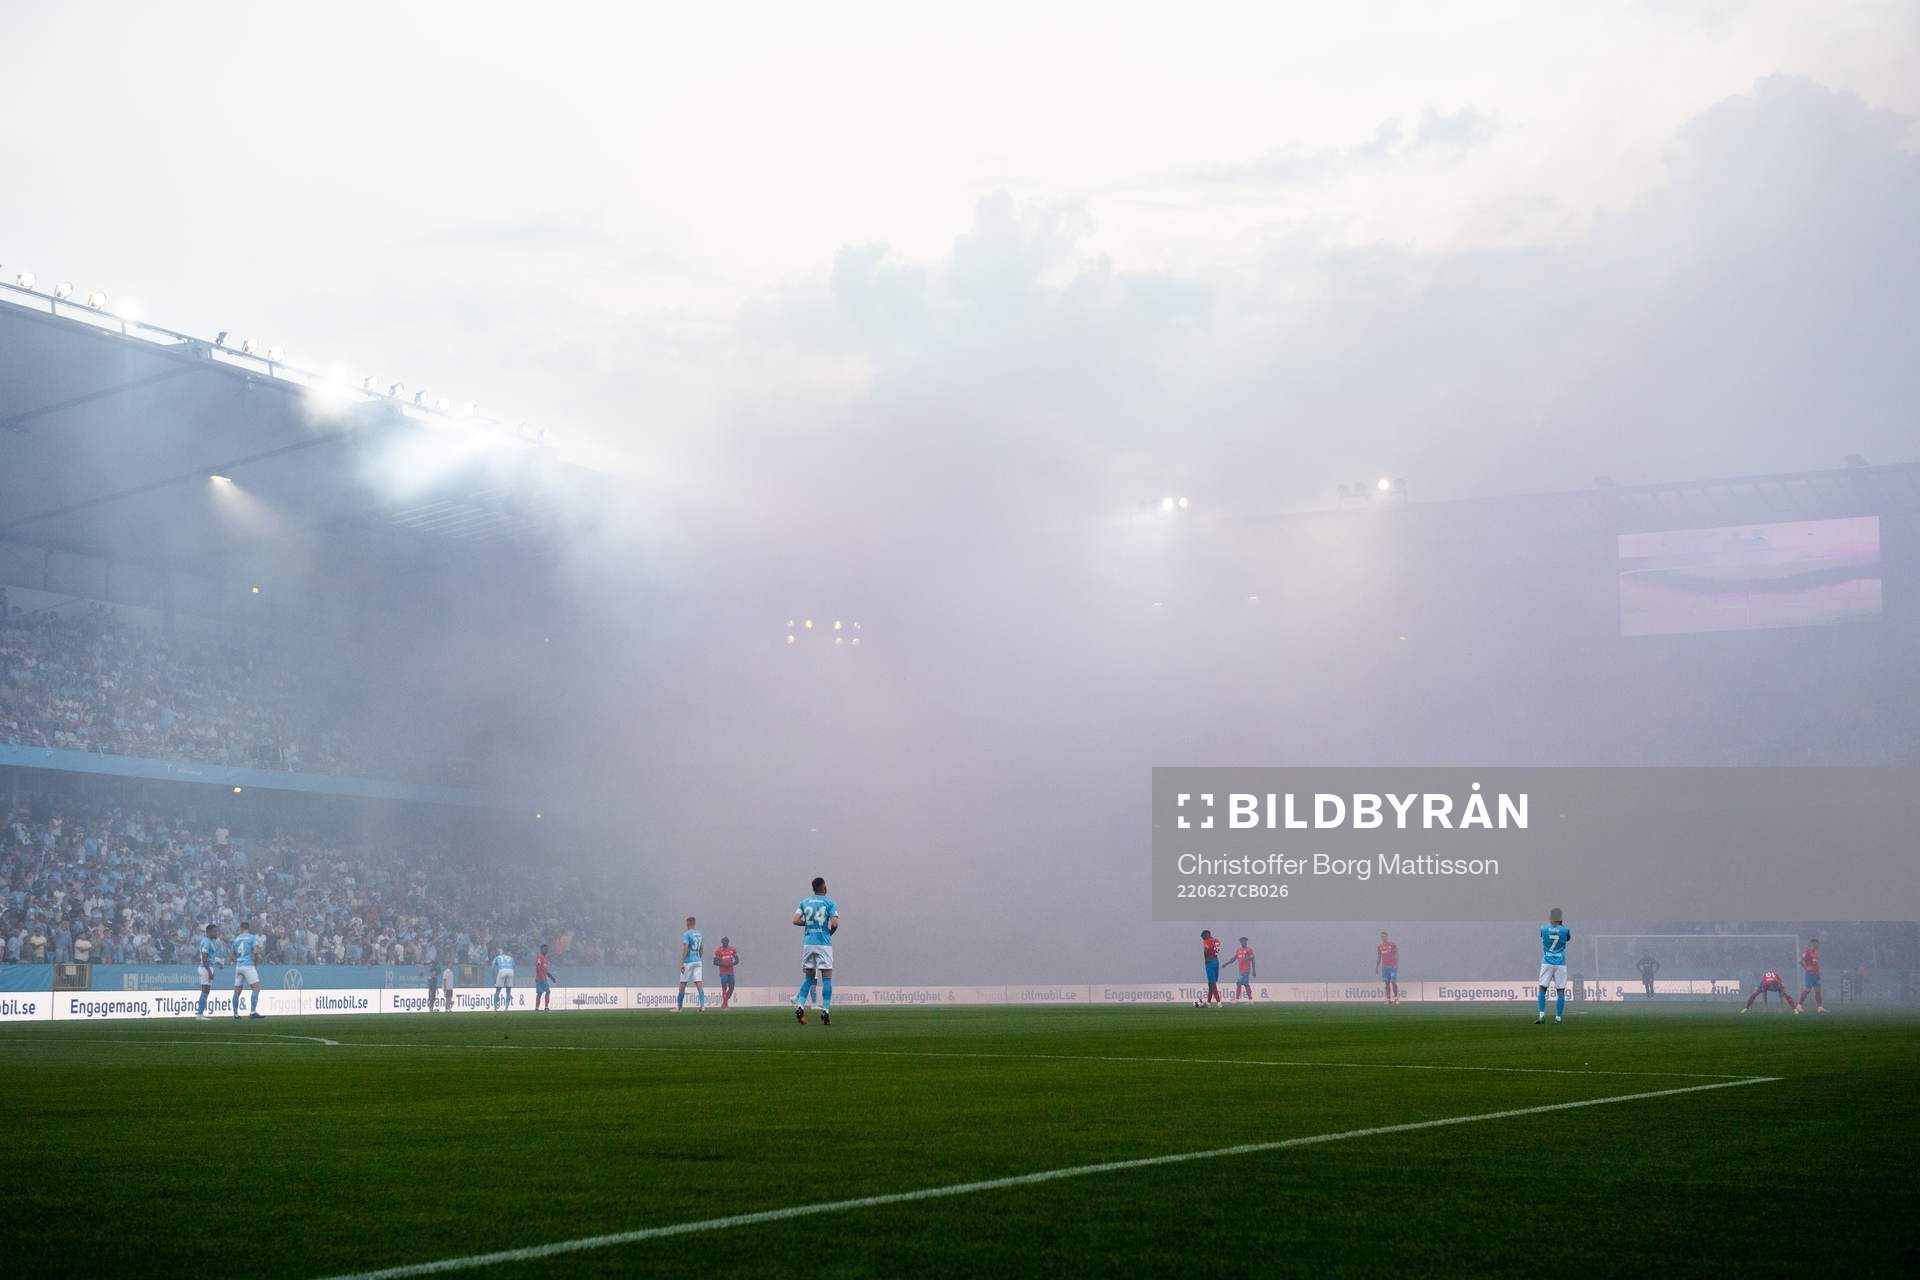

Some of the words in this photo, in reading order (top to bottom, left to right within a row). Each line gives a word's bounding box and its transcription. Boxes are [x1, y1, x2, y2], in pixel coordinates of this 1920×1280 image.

[804, 905, 827, 925] 24
[238, 941, 246, 957] 4
[1549, 935, 1560, 952] 7
[519, 993, 525, 1006] &
[1021, 990, 1077, 1001] tillmobil.se
[1104, 989, 1175, 1002] Engagemang,
[1261, 988, 1269, 998] &
[1439, 986, 1518, 999] Engagemang,
[1616, 986, 1623, 997] &
[0, 1001, 36, 1015] bil.se
[70, 998, 151, 1017] Engagemang,
[239, 997, 247, 1010] &
[315, 996, 368, 1010] tillmobil.se
